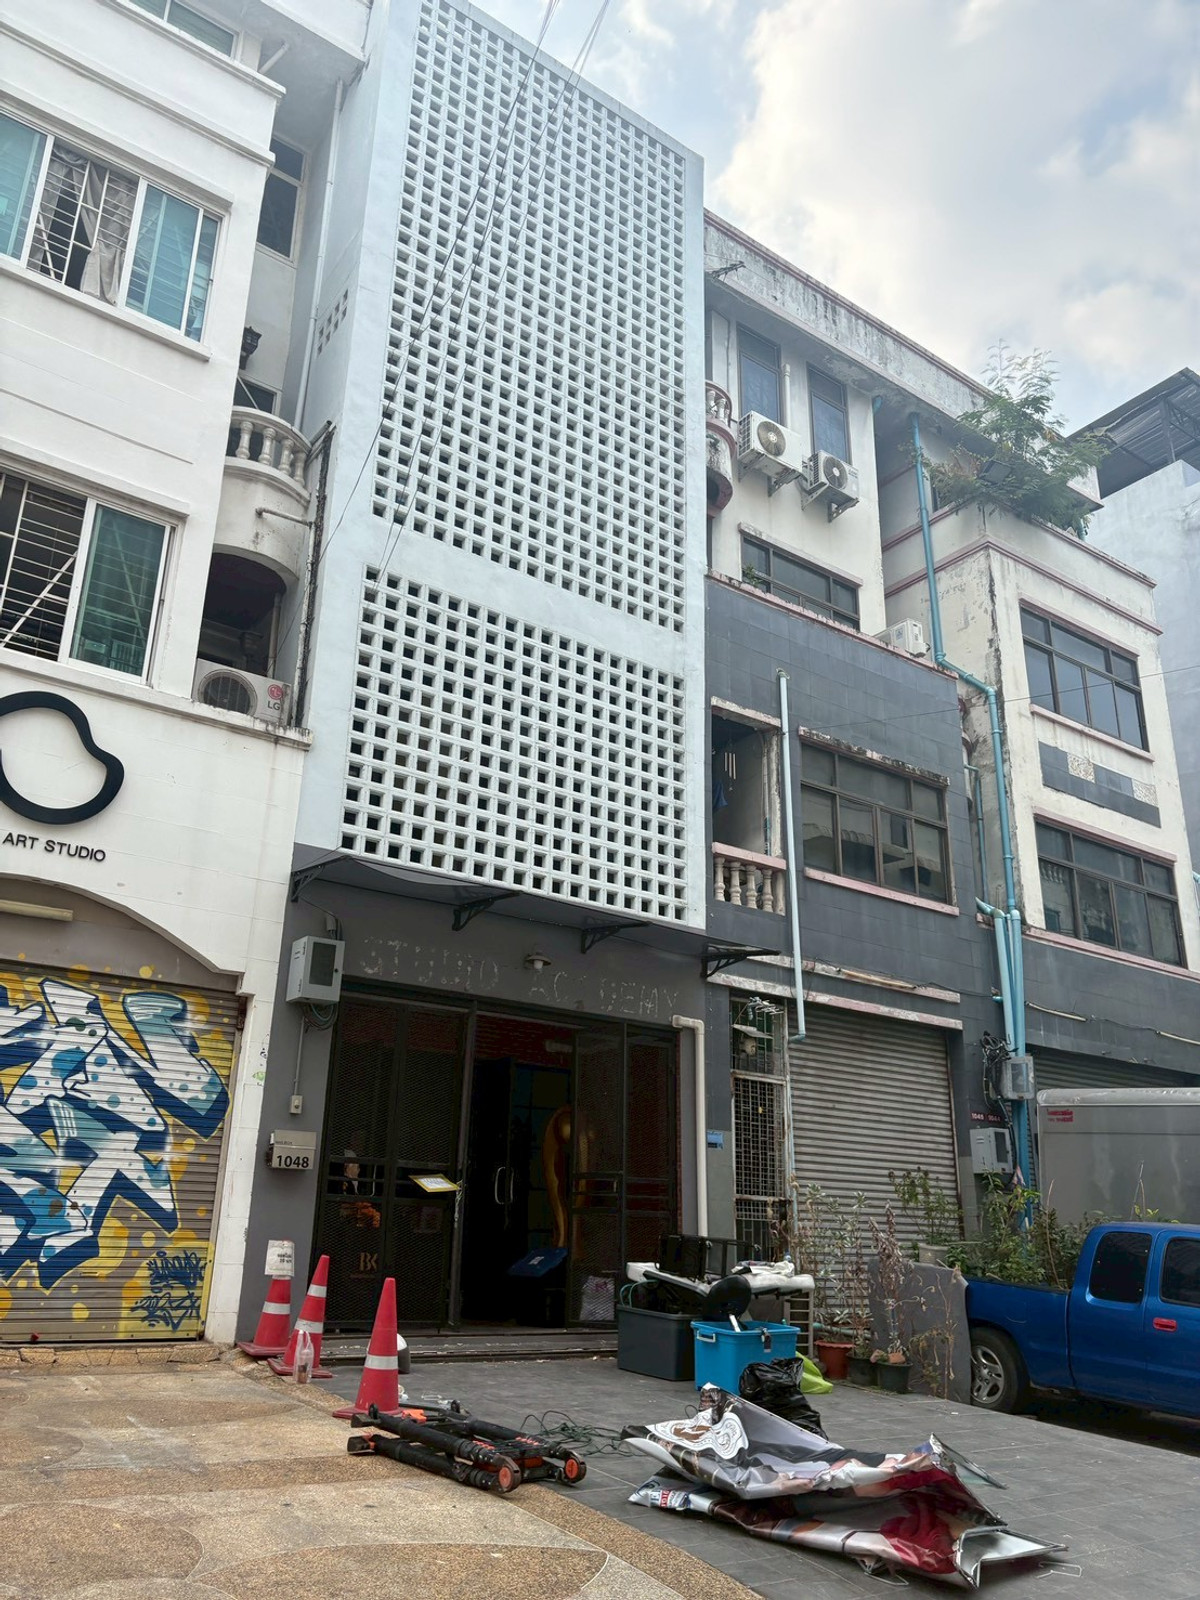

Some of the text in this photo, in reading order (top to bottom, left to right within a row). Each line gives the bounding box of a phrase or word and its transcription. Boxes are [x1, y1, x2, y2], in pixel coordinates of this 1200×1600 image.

[267, 700, 281, 711] LG
[2, 832, 106, 862] ART STUDIO
[276, 1154, 309, 1169] 1048
